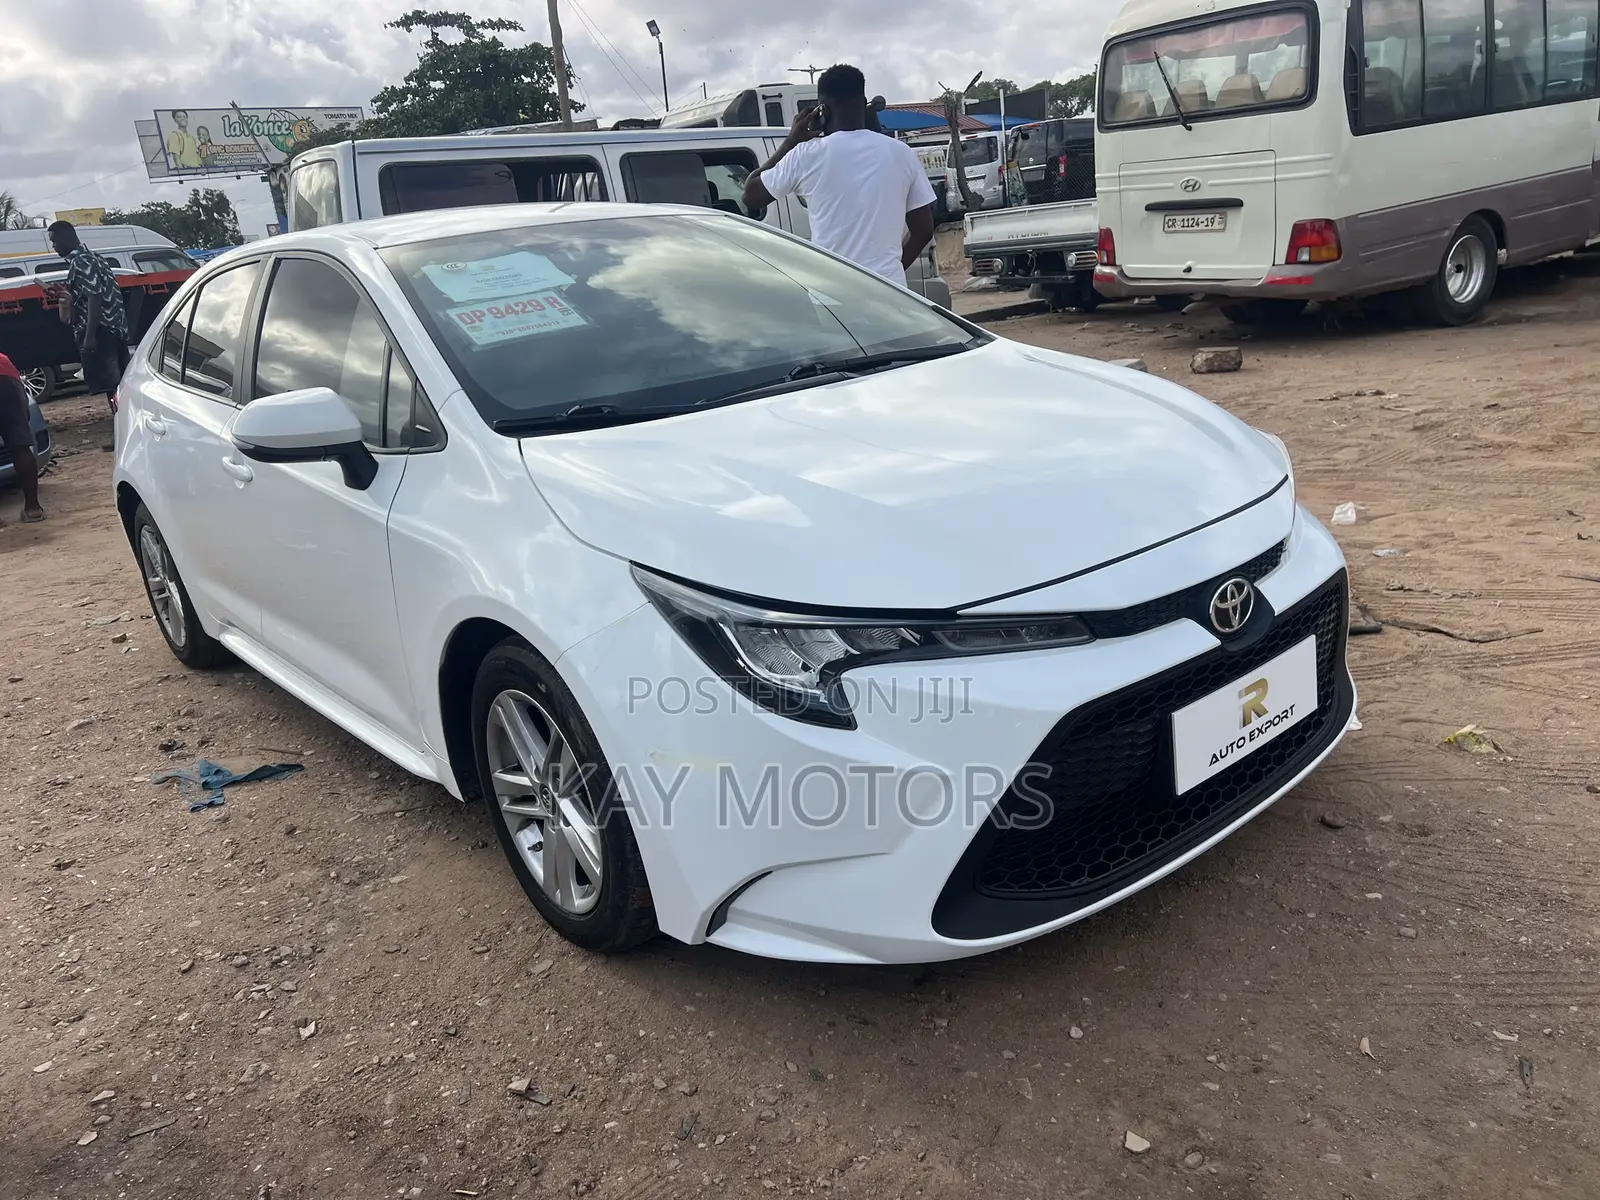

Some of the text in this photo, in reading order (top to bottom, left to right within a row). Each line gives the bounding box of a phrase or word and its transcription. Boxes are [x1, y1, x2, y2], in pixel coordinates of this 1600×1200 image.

[1181, 217, 1215, 228] 1124-19
[455, 309, 487, 325] DP
[486, 297, 546, 319] 9429
[1208, 704, 1296, 767] AUTO EXPORT
